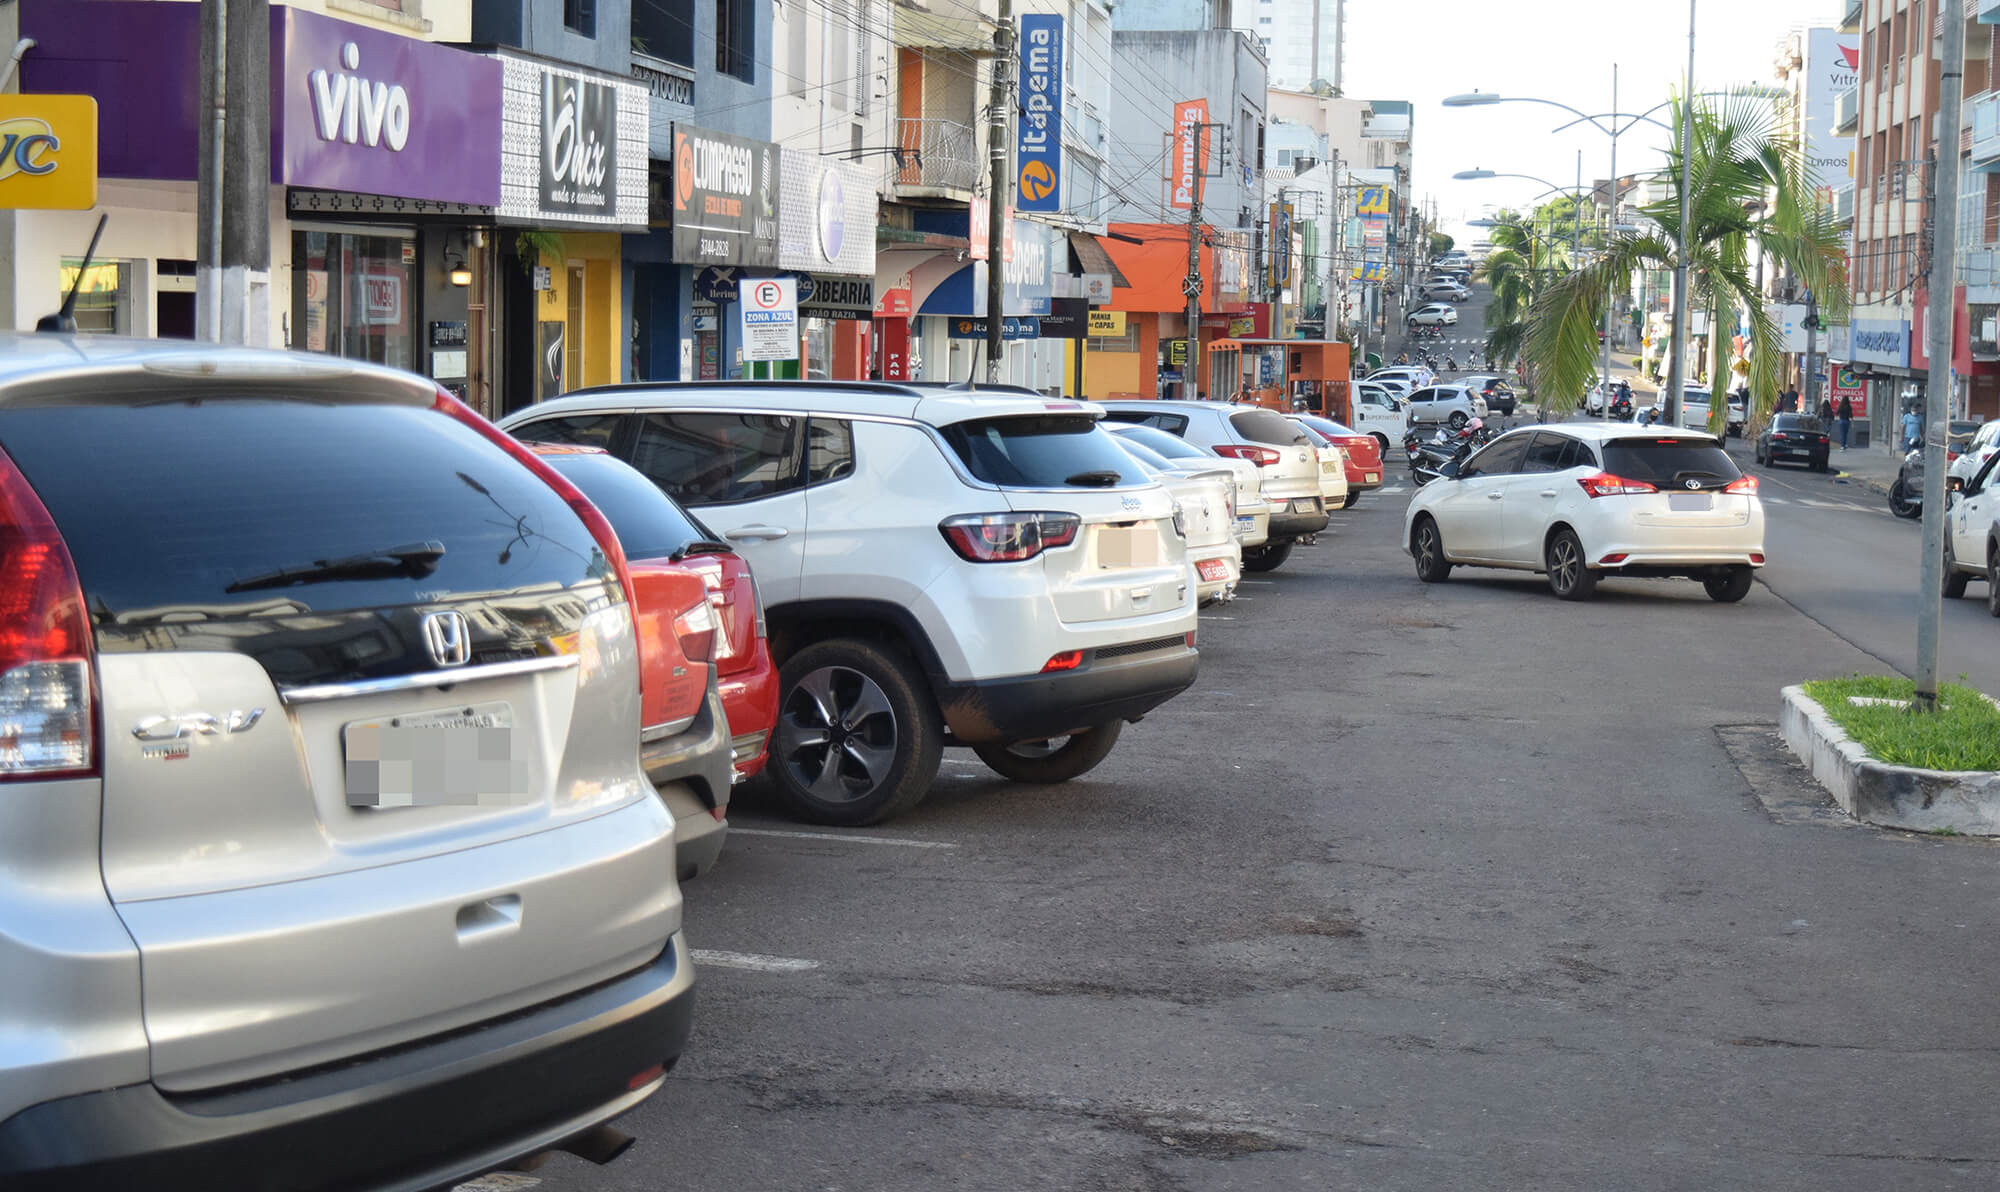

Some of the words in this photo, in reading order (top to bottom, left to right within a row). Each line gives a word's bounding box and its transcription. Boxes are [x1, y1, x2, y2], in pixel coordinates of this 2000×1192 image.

[312, 42, 409, 152] vivo
[1020, 28, 1053, 153] itapema
[552, 87, 606, 187] Ônix
[693, 137, 753, 196] COMPASSO
[1811, 158, 1848, 167] LIVROS
[710, 289, 738, 300] Hering
[763, 287, 774, 303] E
[813, 279, 871, 305] RBEARIA
[746, 313, 769, 322] ZONA
[771, 312, 793, 321] AZUL
